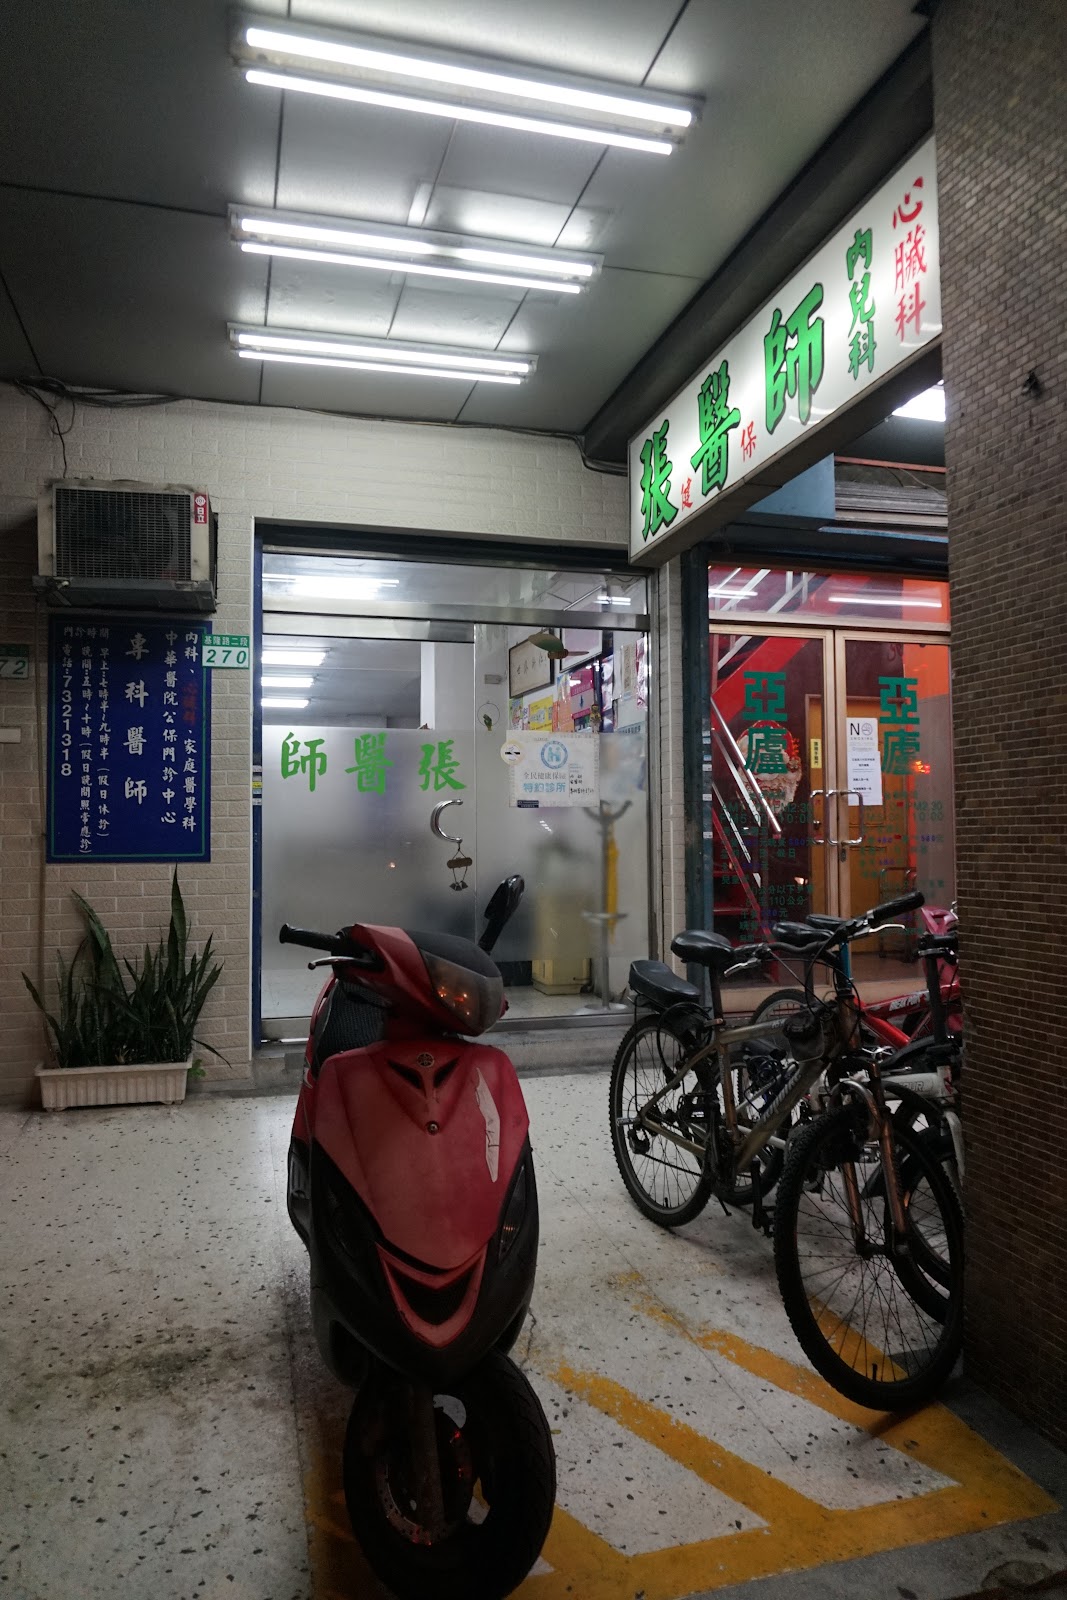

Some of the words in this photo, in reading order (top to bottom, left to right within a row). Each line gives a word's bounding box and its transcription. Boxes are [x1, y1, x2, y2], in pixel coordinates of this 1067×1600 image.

[893, 176, 927, 340] 心臟科
[847, 228, 877, 381] 內兒科
[196, 507, 205, 523] 日立
[204, 635, 248, 647] 基隆路二段
[206, 649, 247, 665] 270
[523, 782, 566, 793] 特約診所
